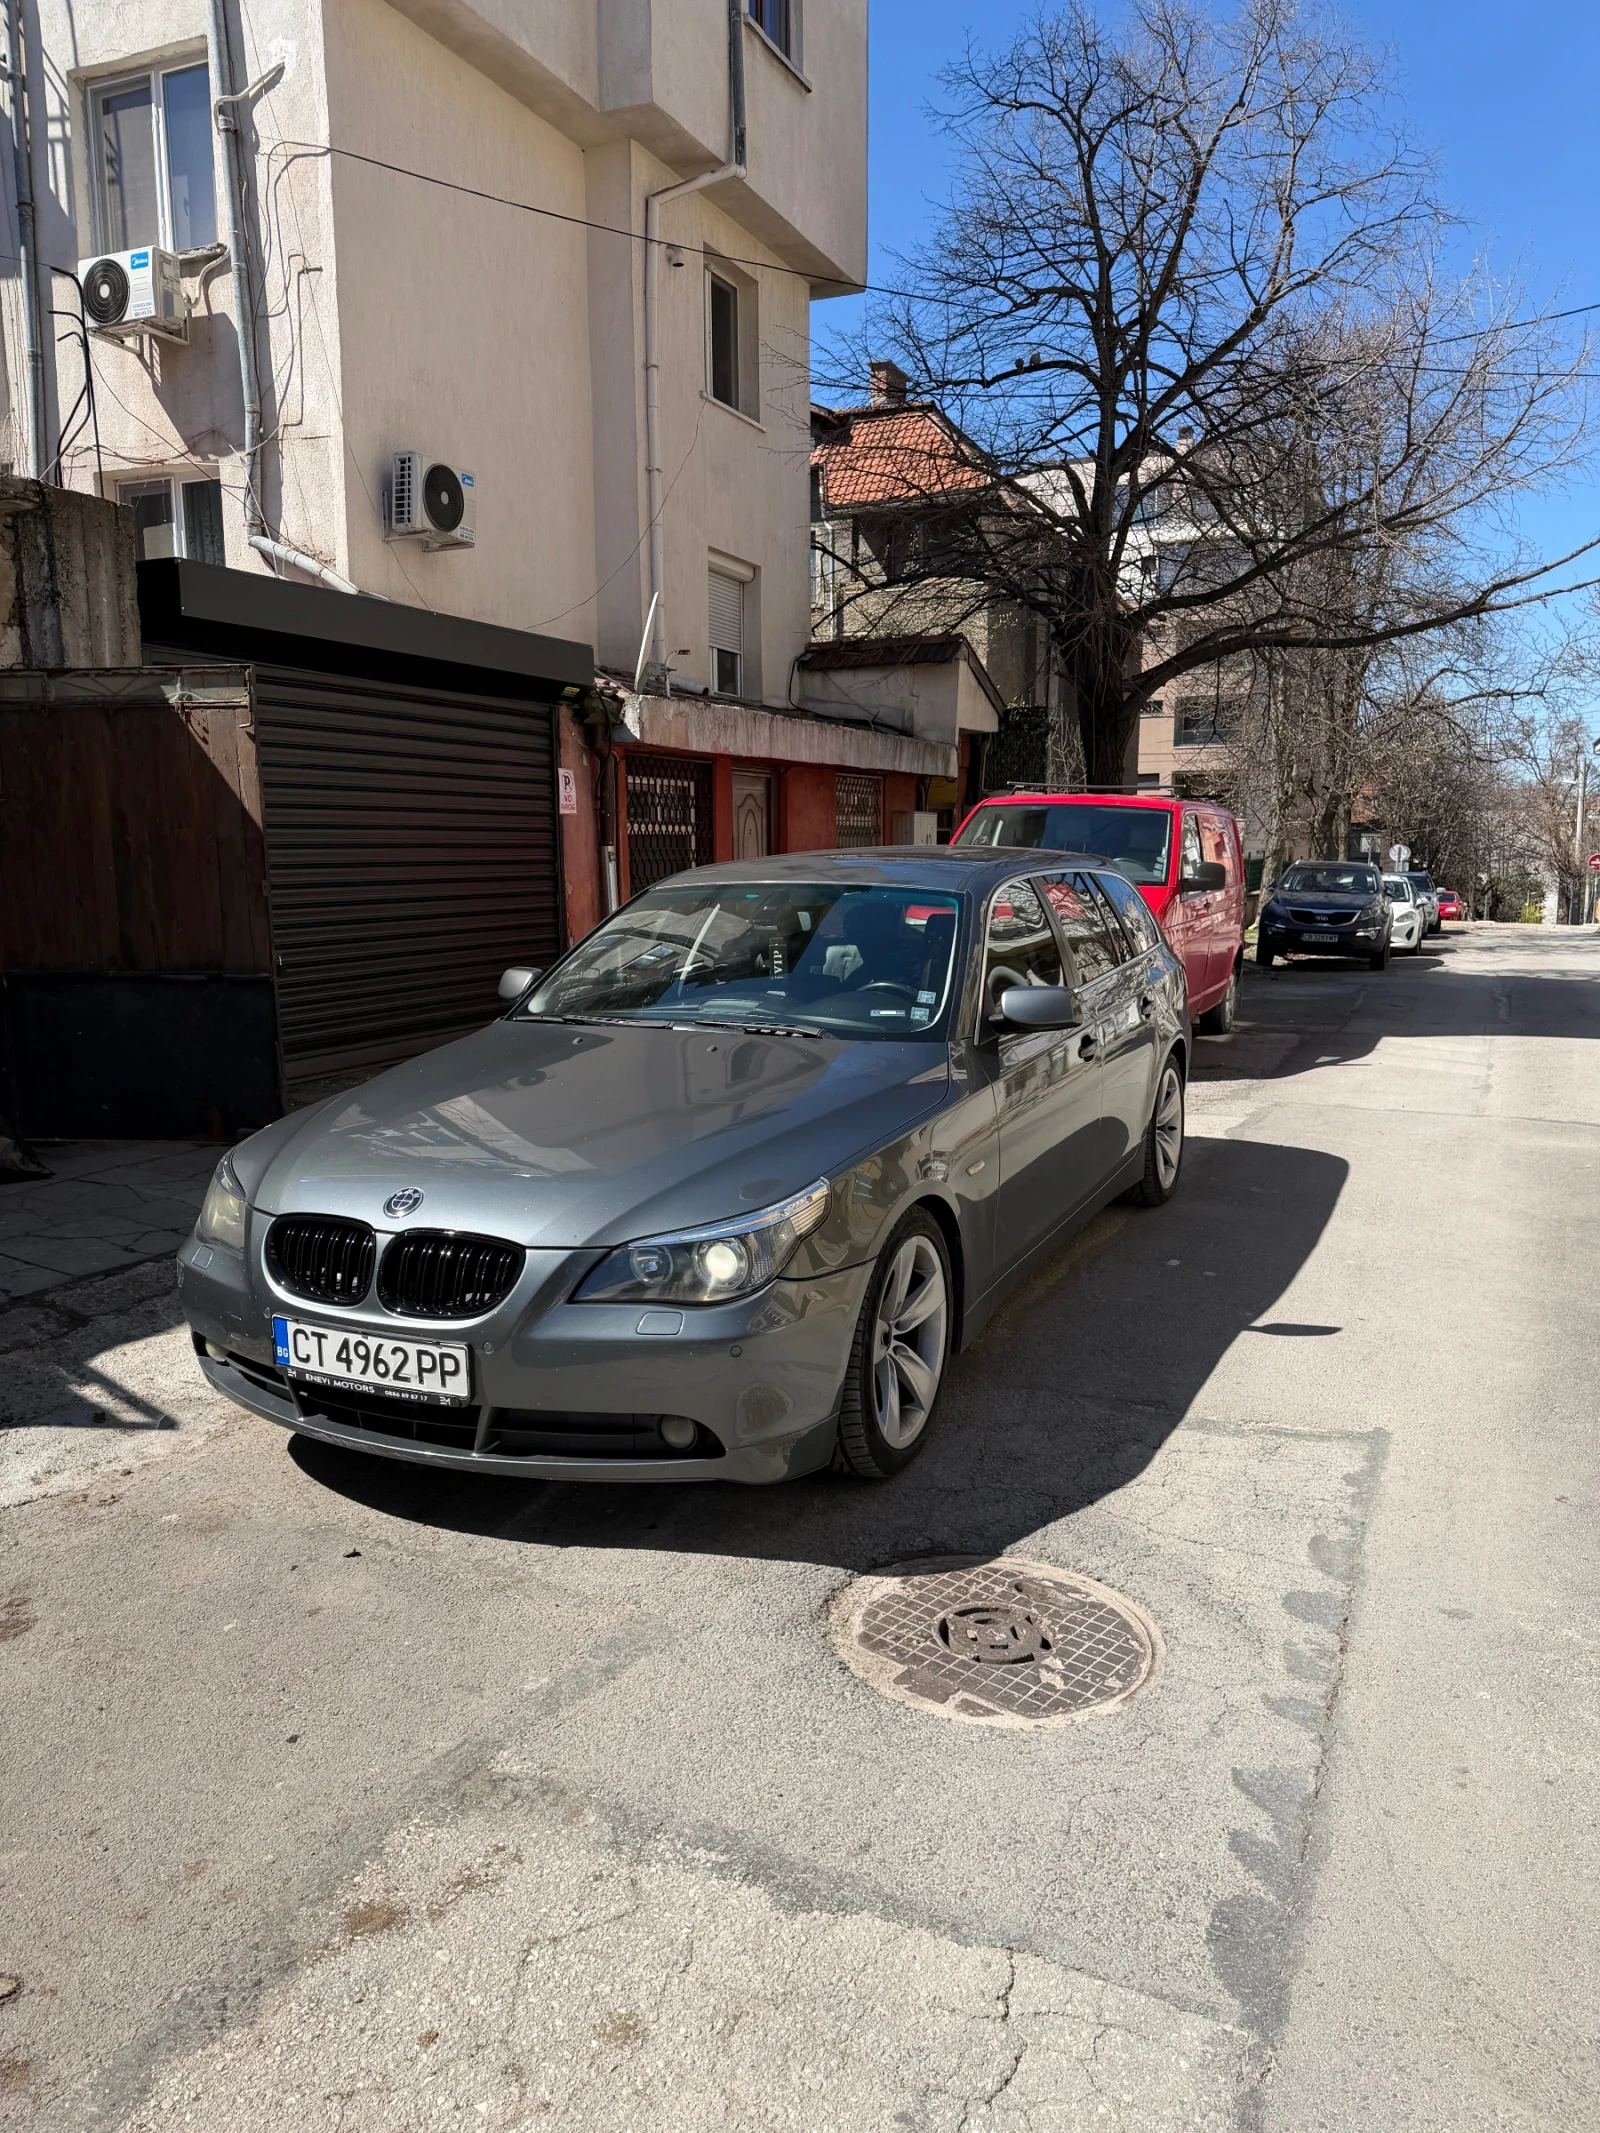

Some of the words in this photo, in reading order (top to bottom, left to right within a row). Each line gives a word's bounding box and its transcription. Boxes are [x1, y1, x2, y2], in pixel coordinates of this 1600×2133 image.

[564, 794, 572, 803] NO
[773, 950, 783, 975] VIP
[277, 1346, 289, 1358] BG
[292, 1328, 328, 1367] CT
[335, 1337, 412, 1383] 4962
[416, 1349, 460, 1388] PP
[305, 1373, 331, 1385] ENEVI
[333, 1380, 375, 1394] MOTORS
